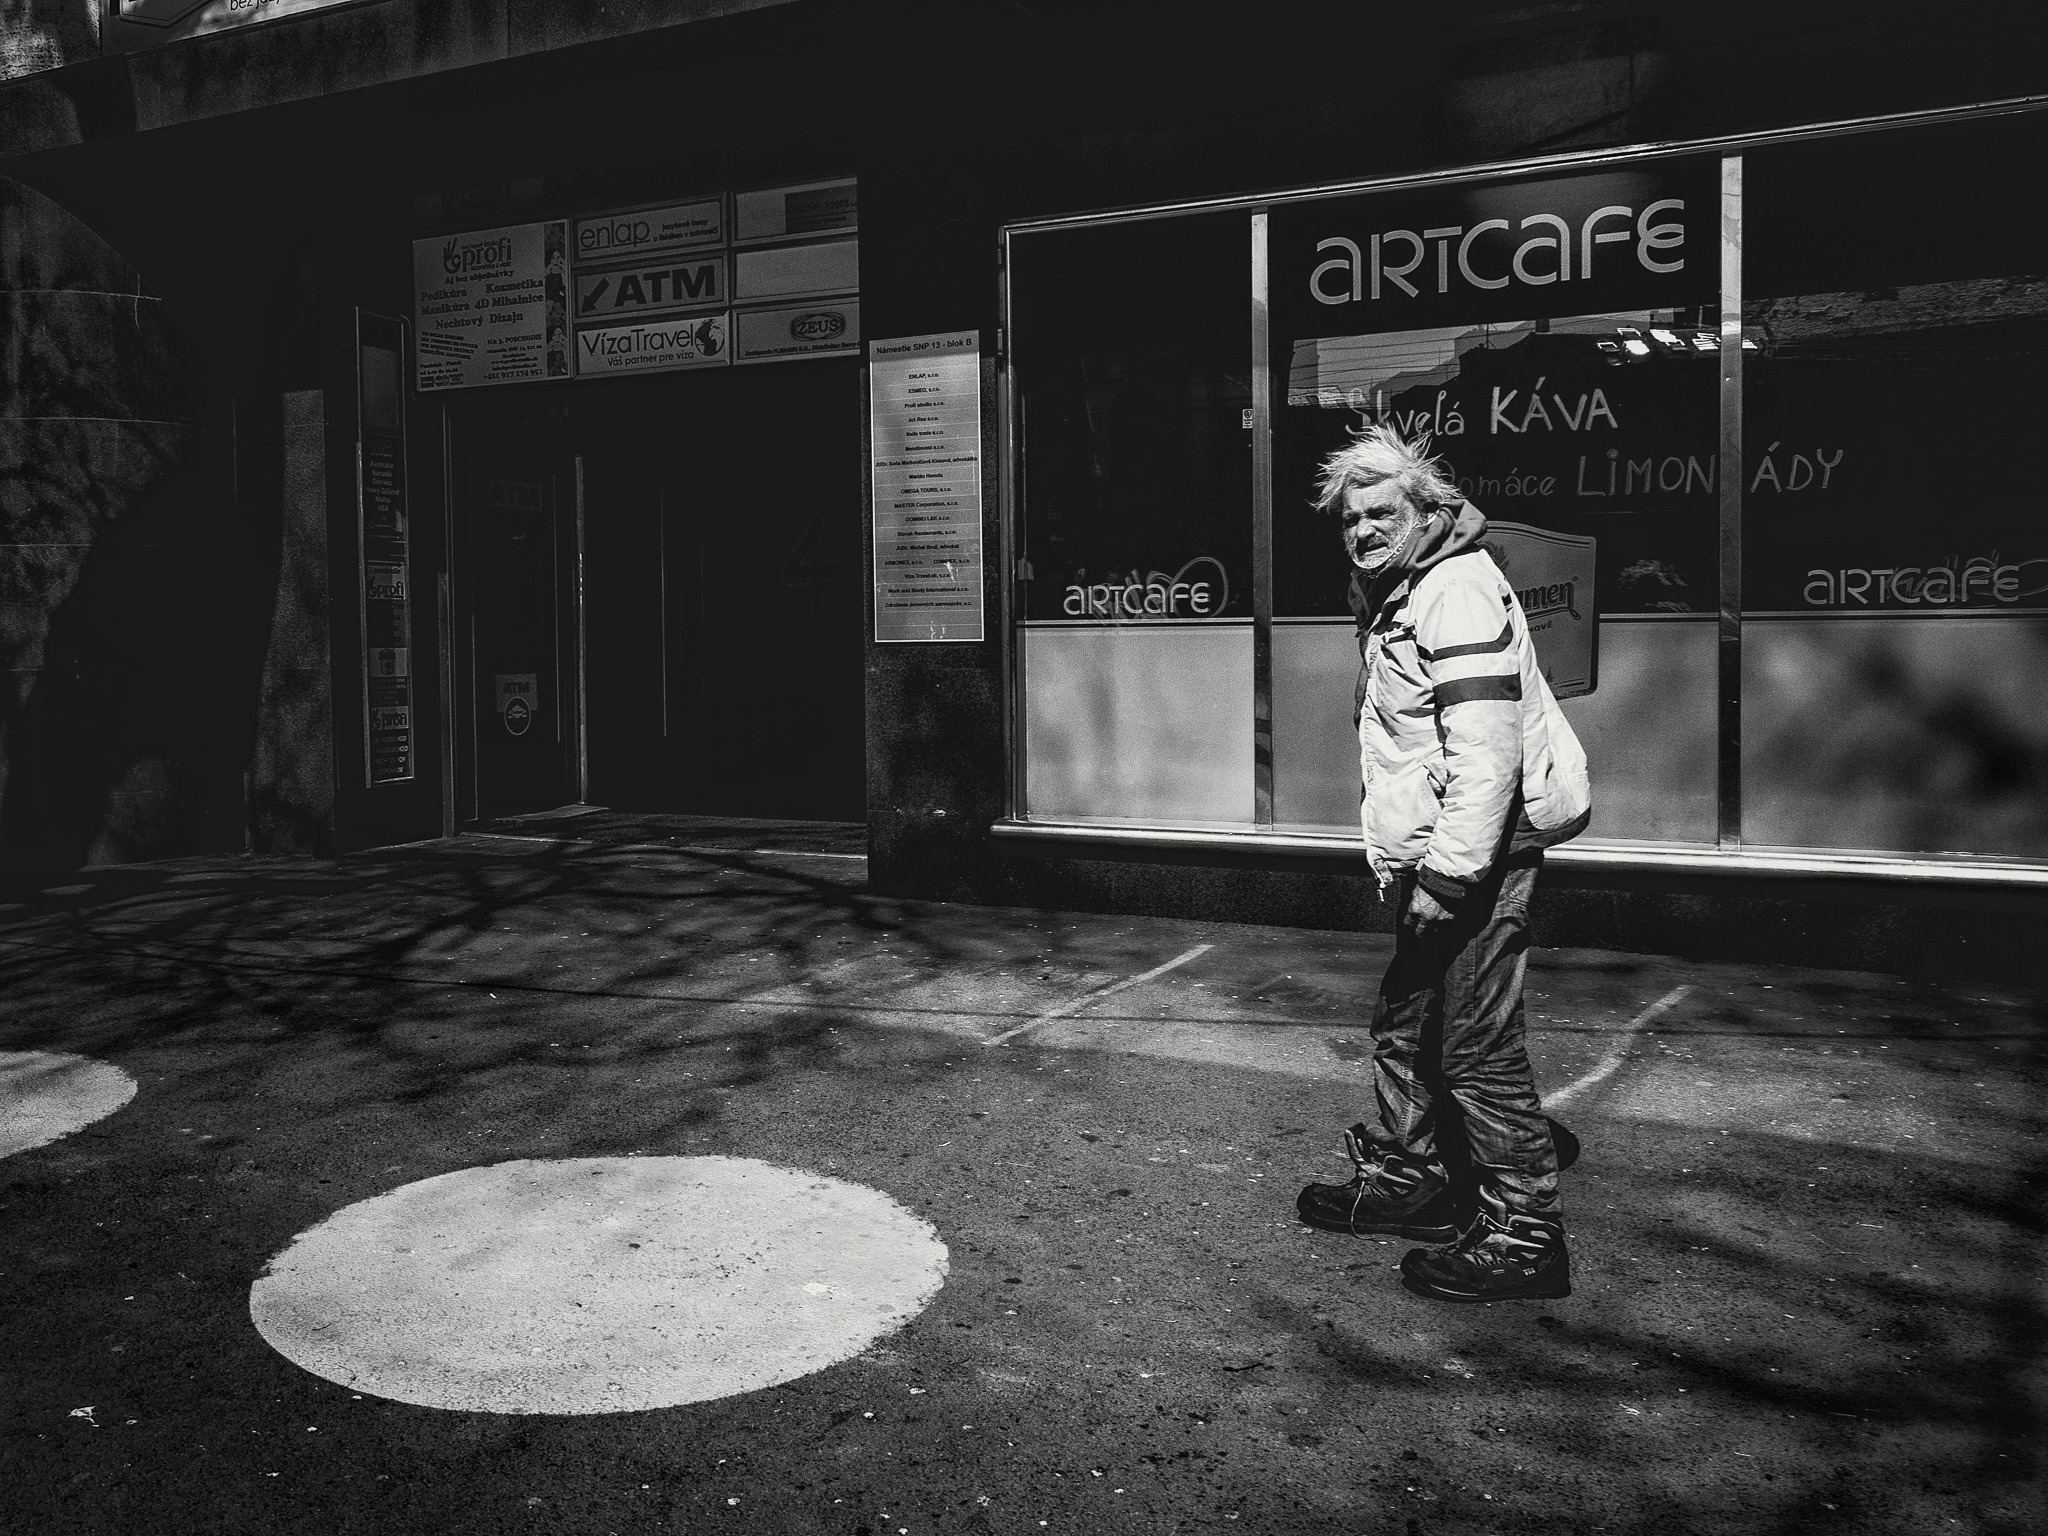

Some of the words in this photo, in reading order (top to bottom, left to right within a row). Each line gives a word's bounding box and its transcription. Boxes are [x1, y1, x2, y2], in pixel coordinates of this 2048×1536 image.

[580, 219, 650, 248] enlap
[462, 237, 512, 272] profi
[421, 288, 468, 301] Pedikúra
[485, 278, 544, 294] Kozmetika
[614, 265, 715, 307] ATM
[421, 302, 470, 315] Manikúra
[475, 298, 490, 310] 4D
[492, 293, 544, 307] Mihalnice
[434, 315, 484, 330] Nechtový
[489, 311, 524, 324] Dizajn
[799, 320, 839, 334] ZEUS
[876, 344, 911, 355] Námestie
[913, 342, 930, 351] SNP
[931, 341, 941, 349] 13
[947, 339, 965, 348] blok
[965, 338, 973, 346] B
[607, 356, 623, 367] Váš
[625, 354, 657, 367] partner
[659, 353, 674, 363] pre
[676, 350, 694, 360] víza
[501, 371, 514, 379] 917
[1490, 376, 1619, 436] KÁVA
[503, 682, 530, 694] ATM
